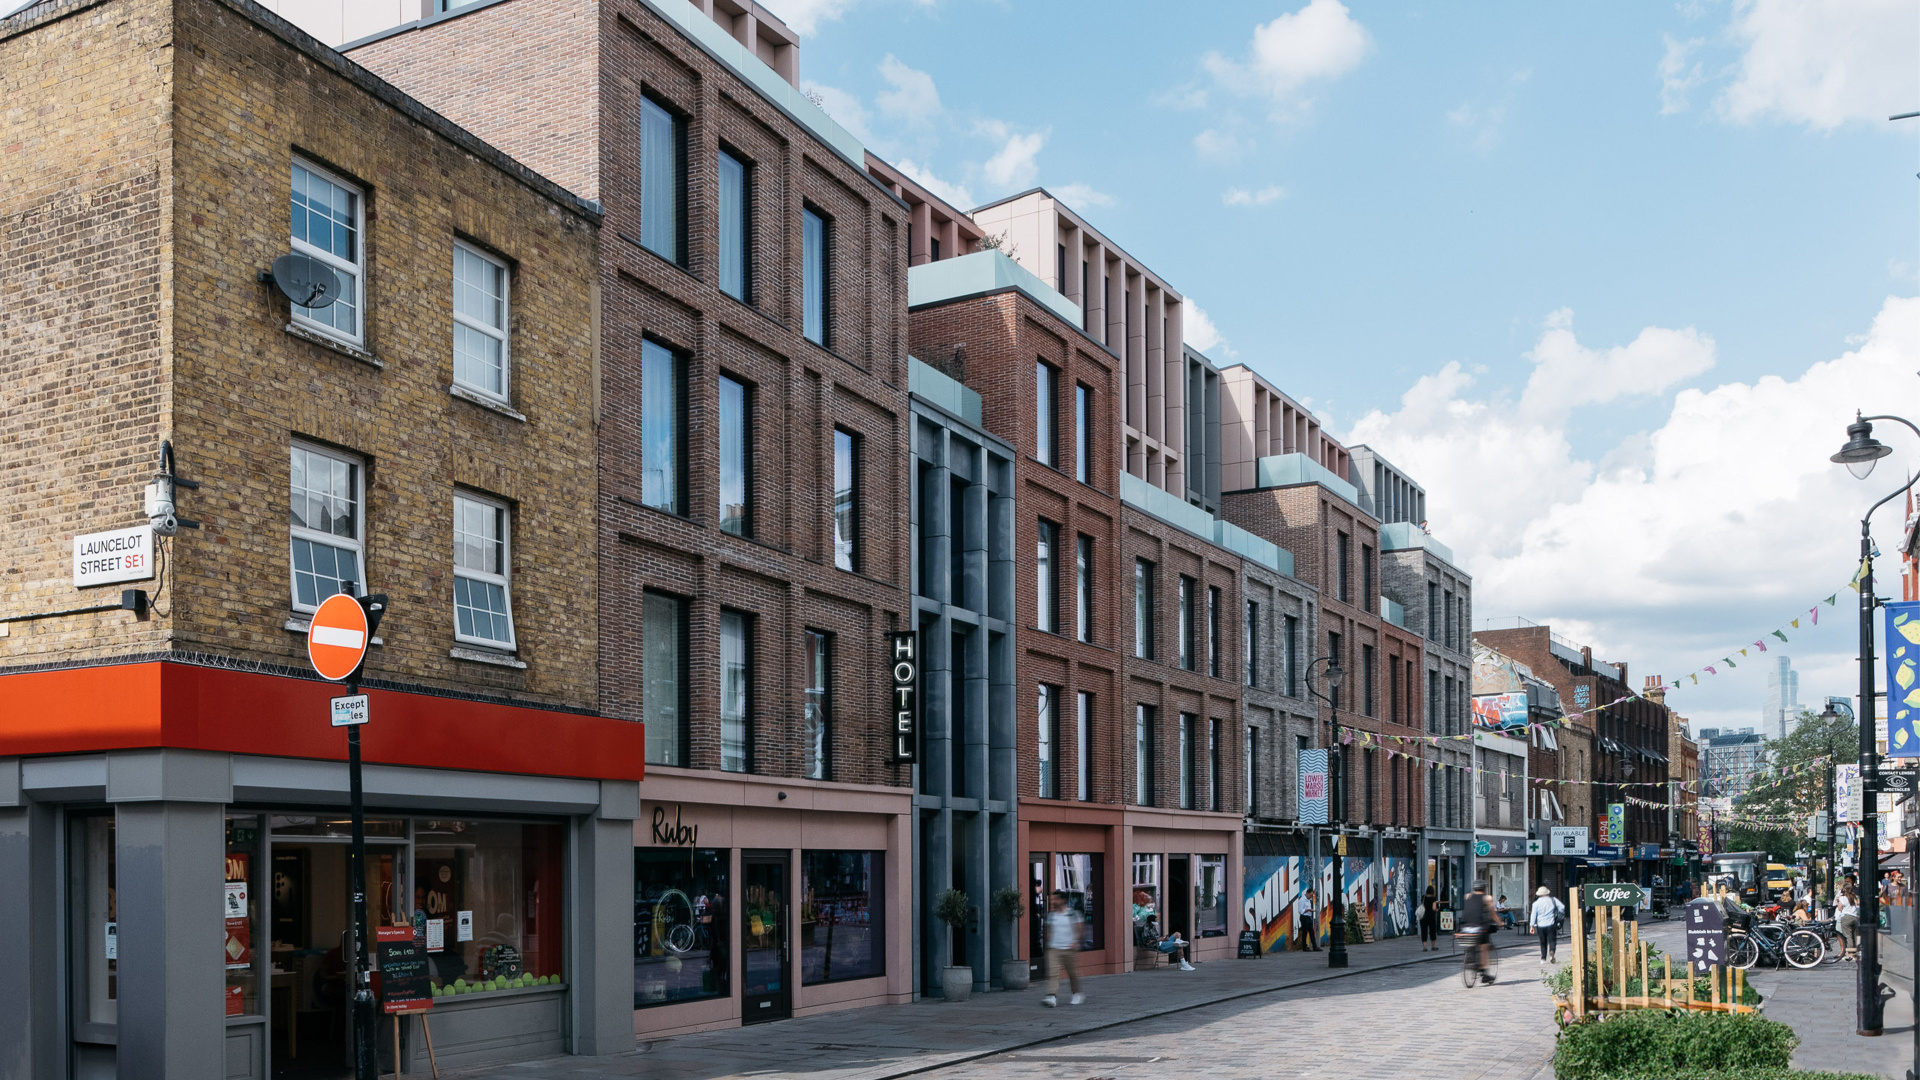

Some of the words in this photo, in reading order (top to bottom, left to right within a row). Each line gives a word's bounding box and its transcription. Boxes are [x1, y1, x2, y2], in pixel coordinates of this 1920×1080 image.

[80, 534, 143, 556] LAUNCELOT
[80, 557, 122, 575] STREET
[125, 554, 144, 569] SE1
[334, 699, 365, 710] Except
[894, 636, 916, 758] HOTEL
[1304, 782, 1324, 790] MARSH
[1304, 790, 1324, 798] MARKET
[652, 804, 698, 873] Ruby
[1600, 820, 1609, 843] 91-94
[1244, 855, 1300, 933] SMILE
[1593, 887, 1631, 902] Coffee
